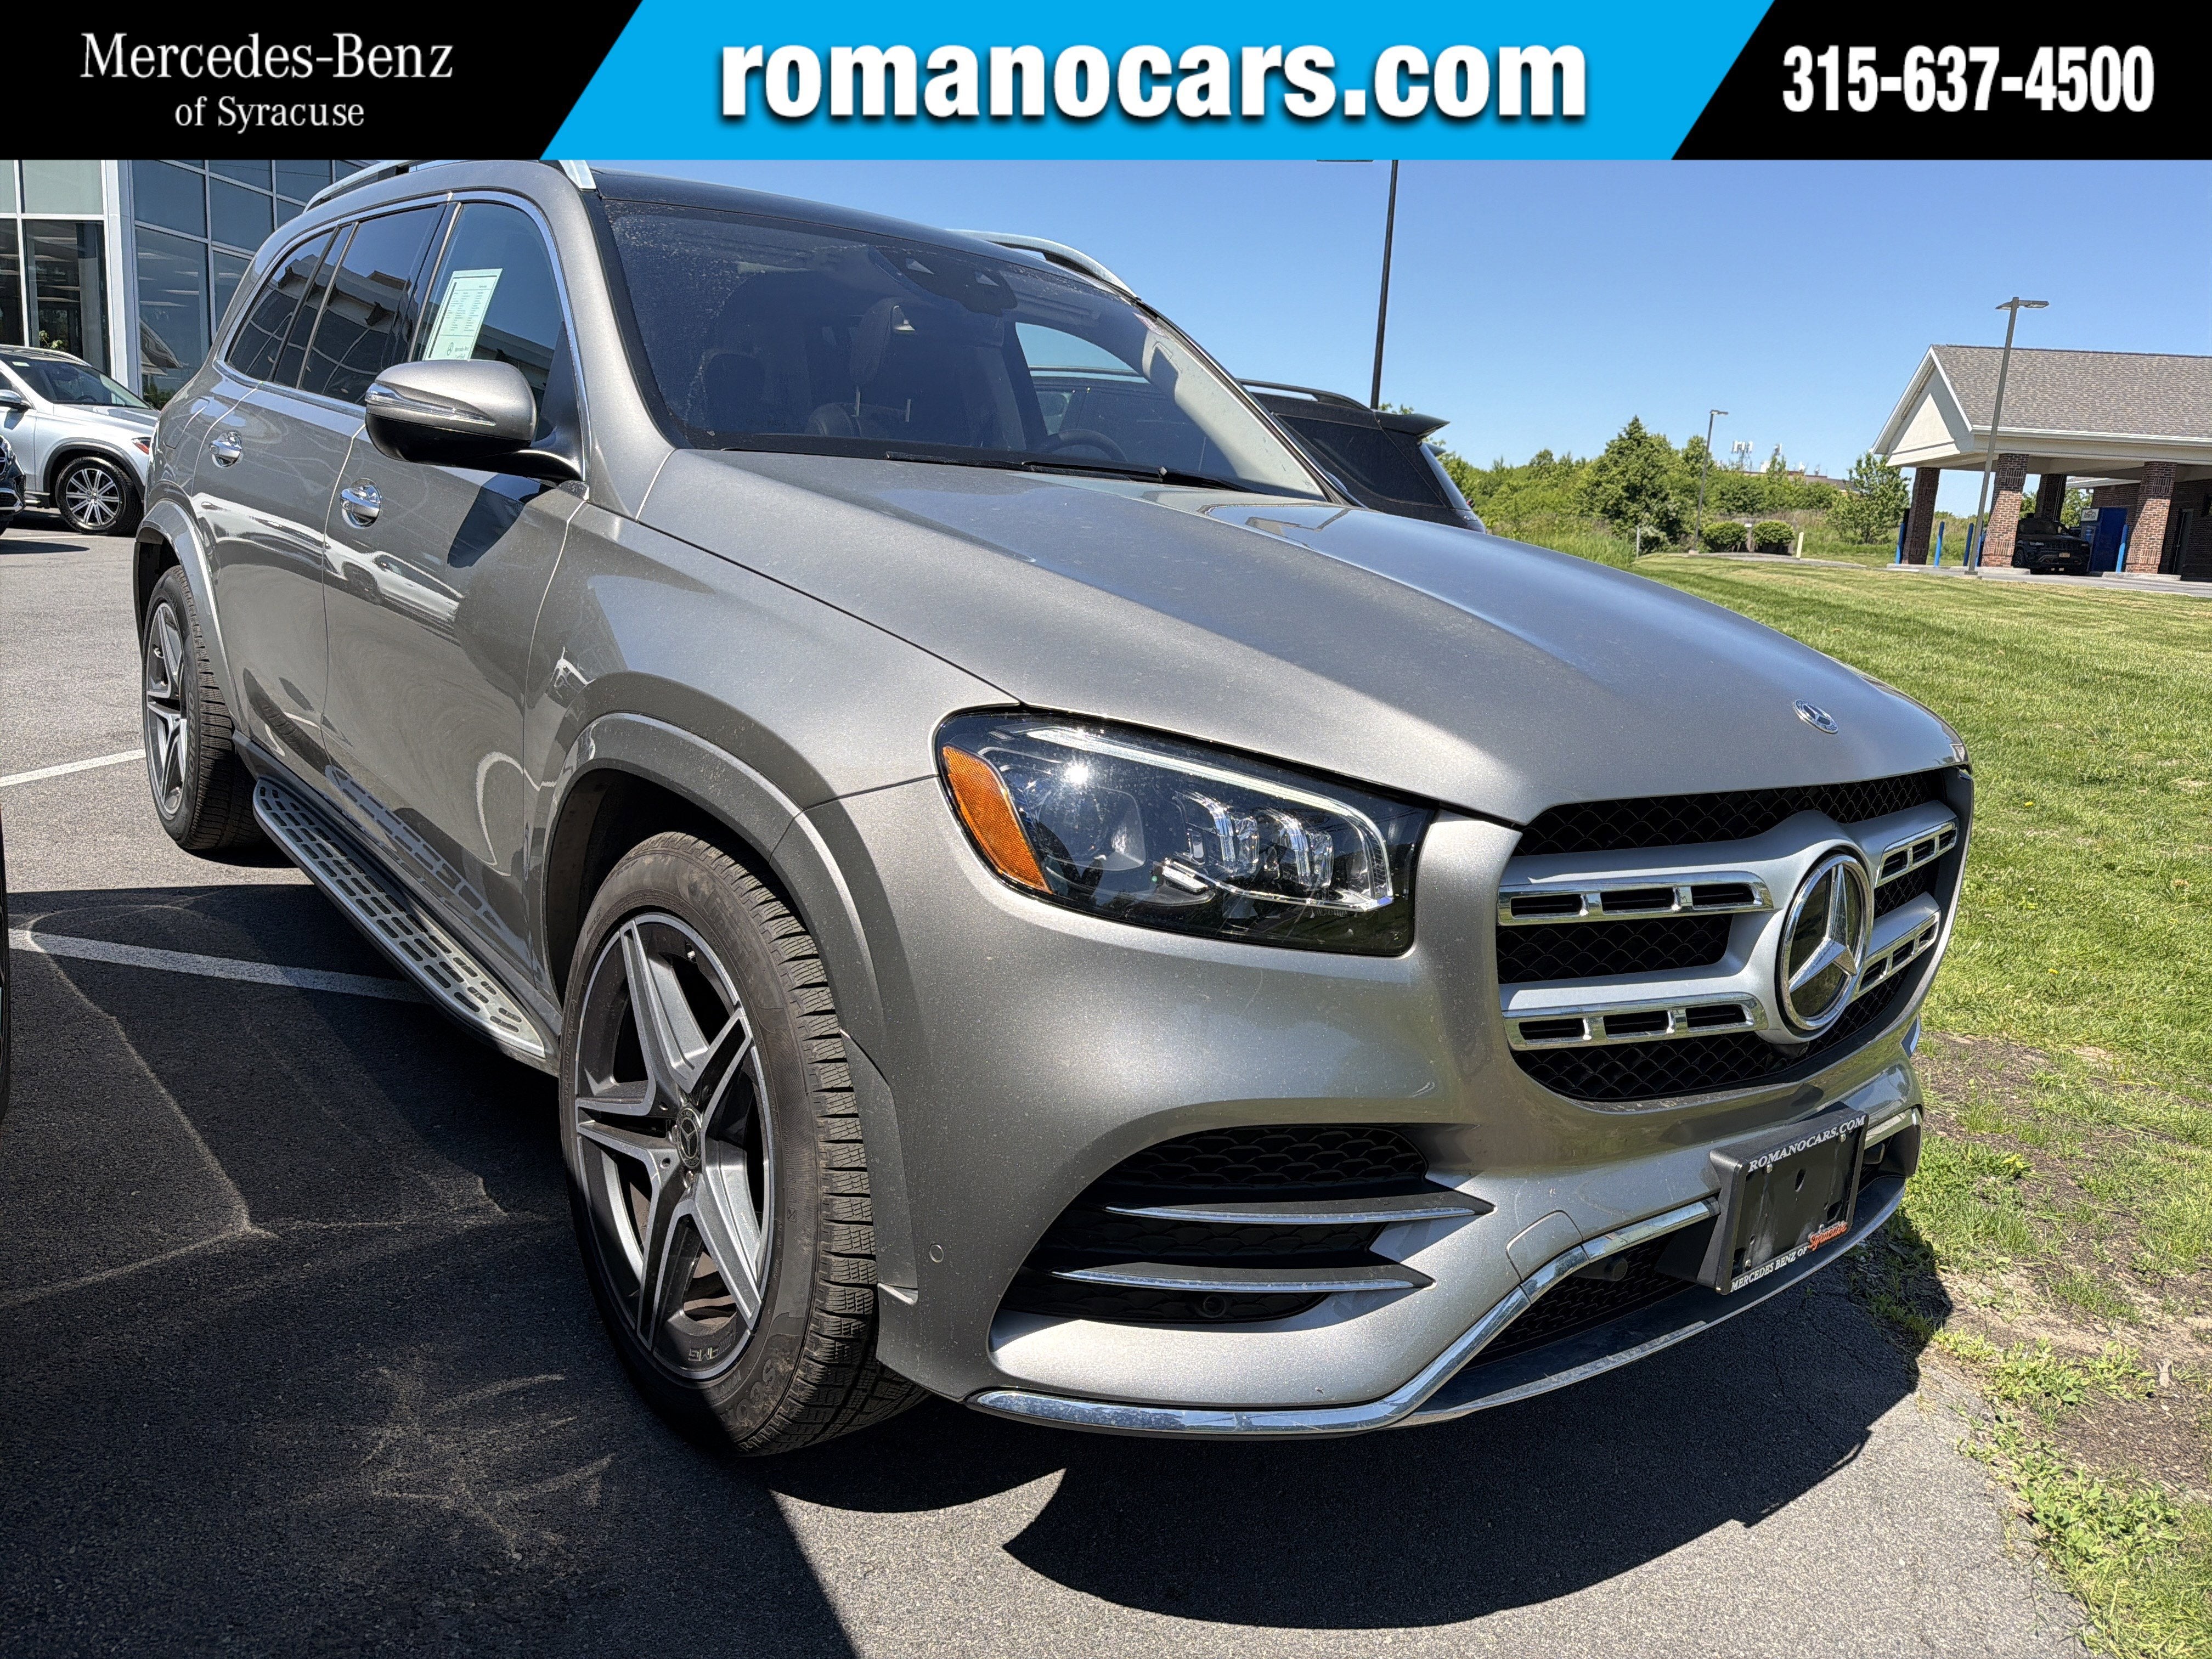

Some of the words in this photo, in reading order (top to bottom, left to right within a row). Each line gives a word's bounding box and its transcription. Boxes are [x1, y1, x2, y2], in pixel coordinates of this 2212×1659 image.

[1748, 1115, 1866, 1173] ROMANOCARS.COM
[1730, 1262, 1774, 1293] MERCEDES
[1774, 1251, 1797, 1271] BENZ
[1797, 1246, 1808, 1257] OF
